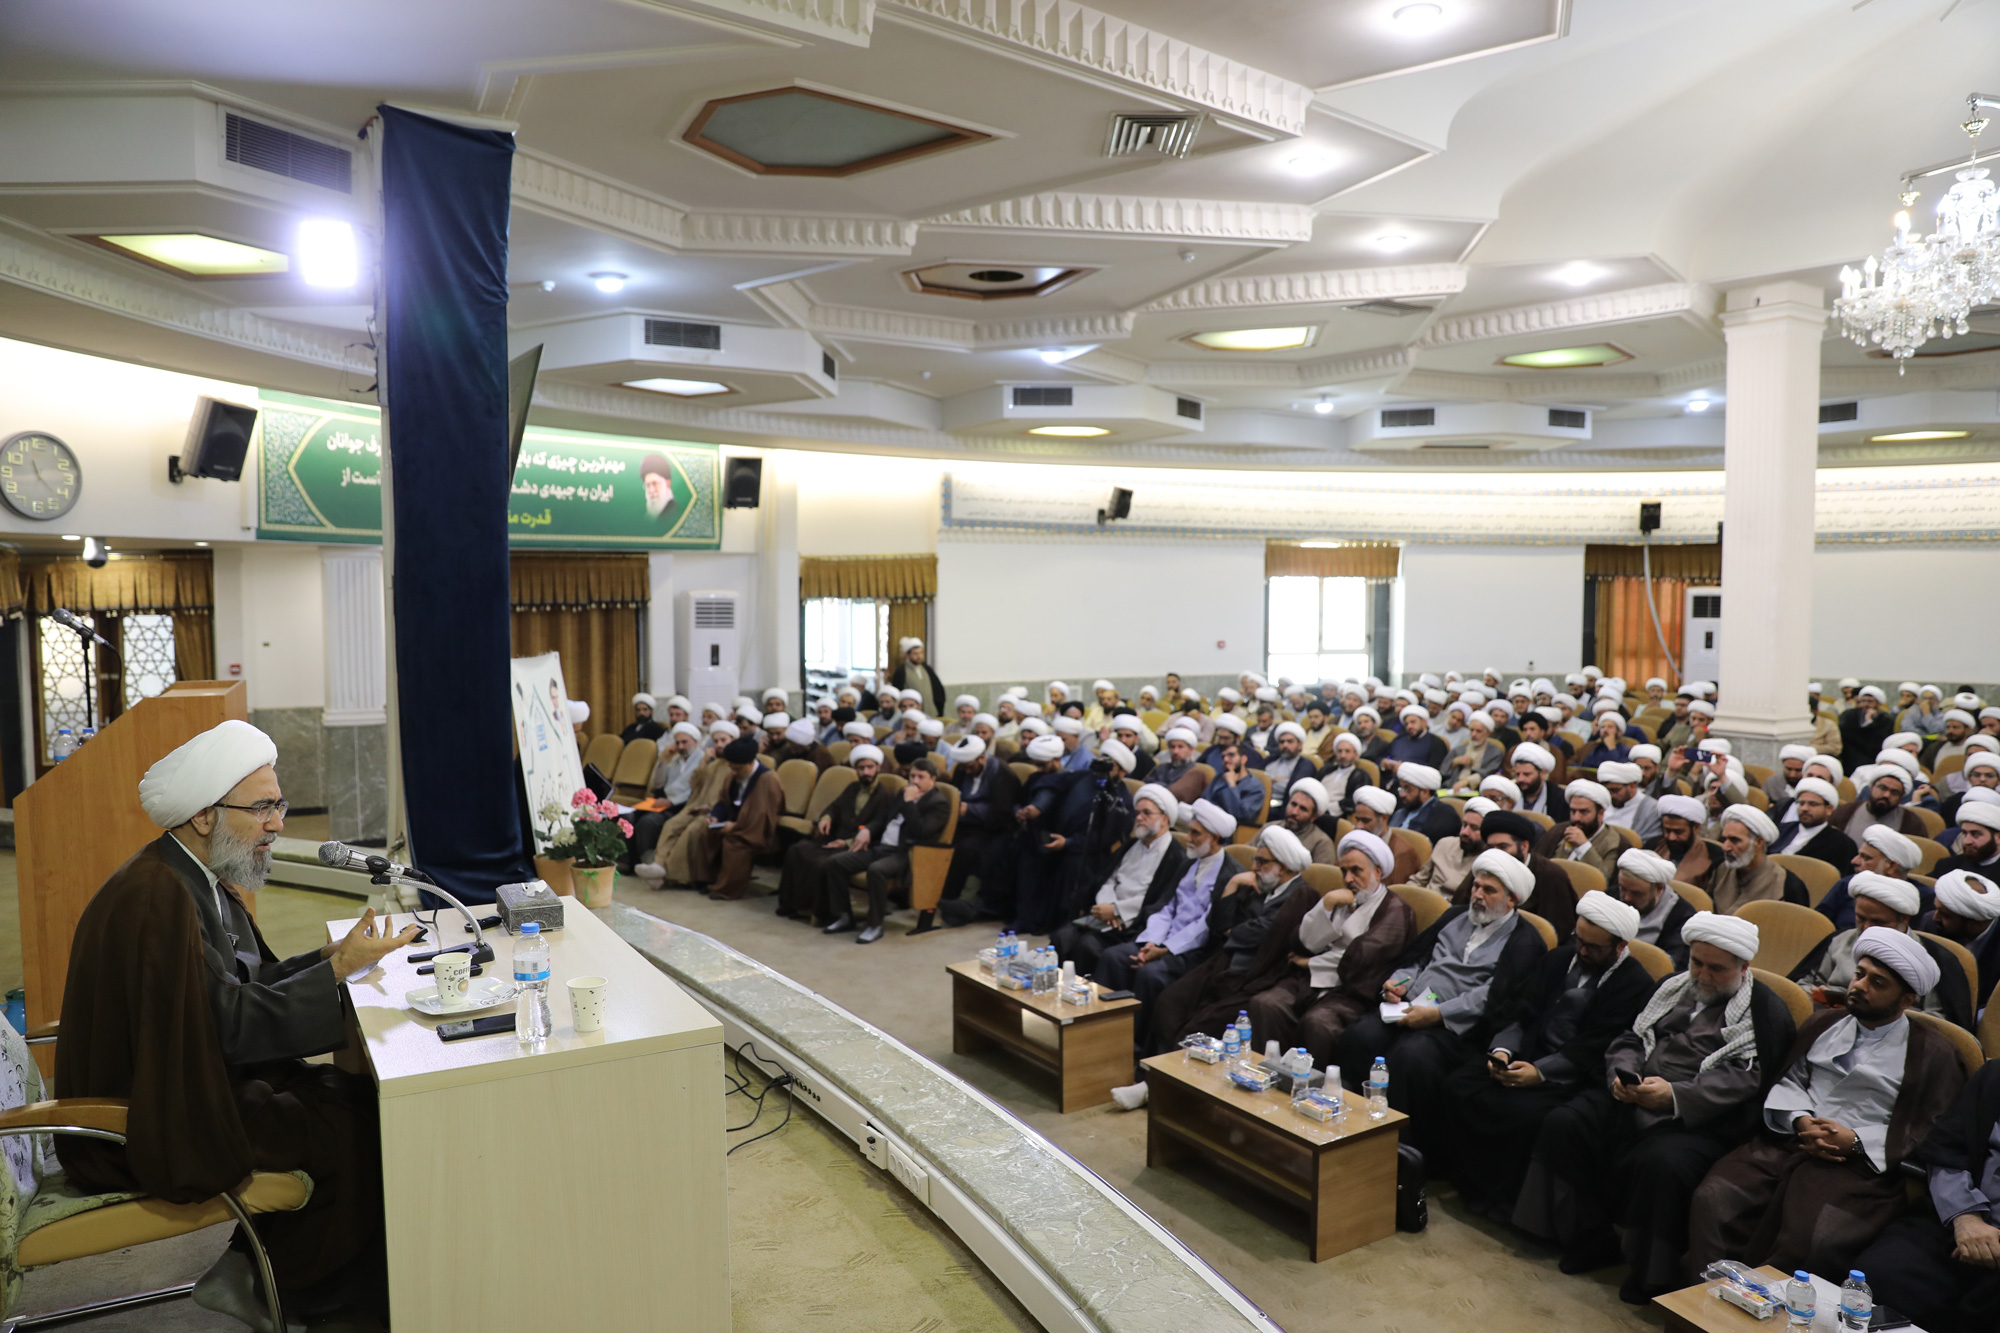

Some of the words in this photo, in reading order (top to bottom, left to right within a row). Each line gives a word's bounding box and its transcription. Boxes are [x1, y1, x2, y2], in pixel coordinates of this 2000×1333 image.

[19, 440, 29, 453] 11
[327, 431, 364, 455] جوانان
[7, 451, 23, 465] 10
[57, 459, 69, 471] 2
[516, 449, 531, 469] بای
[532, 451, 547, 466] که
[547, 455, 578, 475] چیزی
[1, 466, 13, 478] 9
[63, 473, 75, 486] 3
[6, 481, 18, 494] 8
[57, 488, 68, 500] 4
[576, 486, 589, 502] به
[589, 484, 614, 503] ایران
[520, 508, 552, 528] قدرت
[454, 967, 470, 975] COFF
